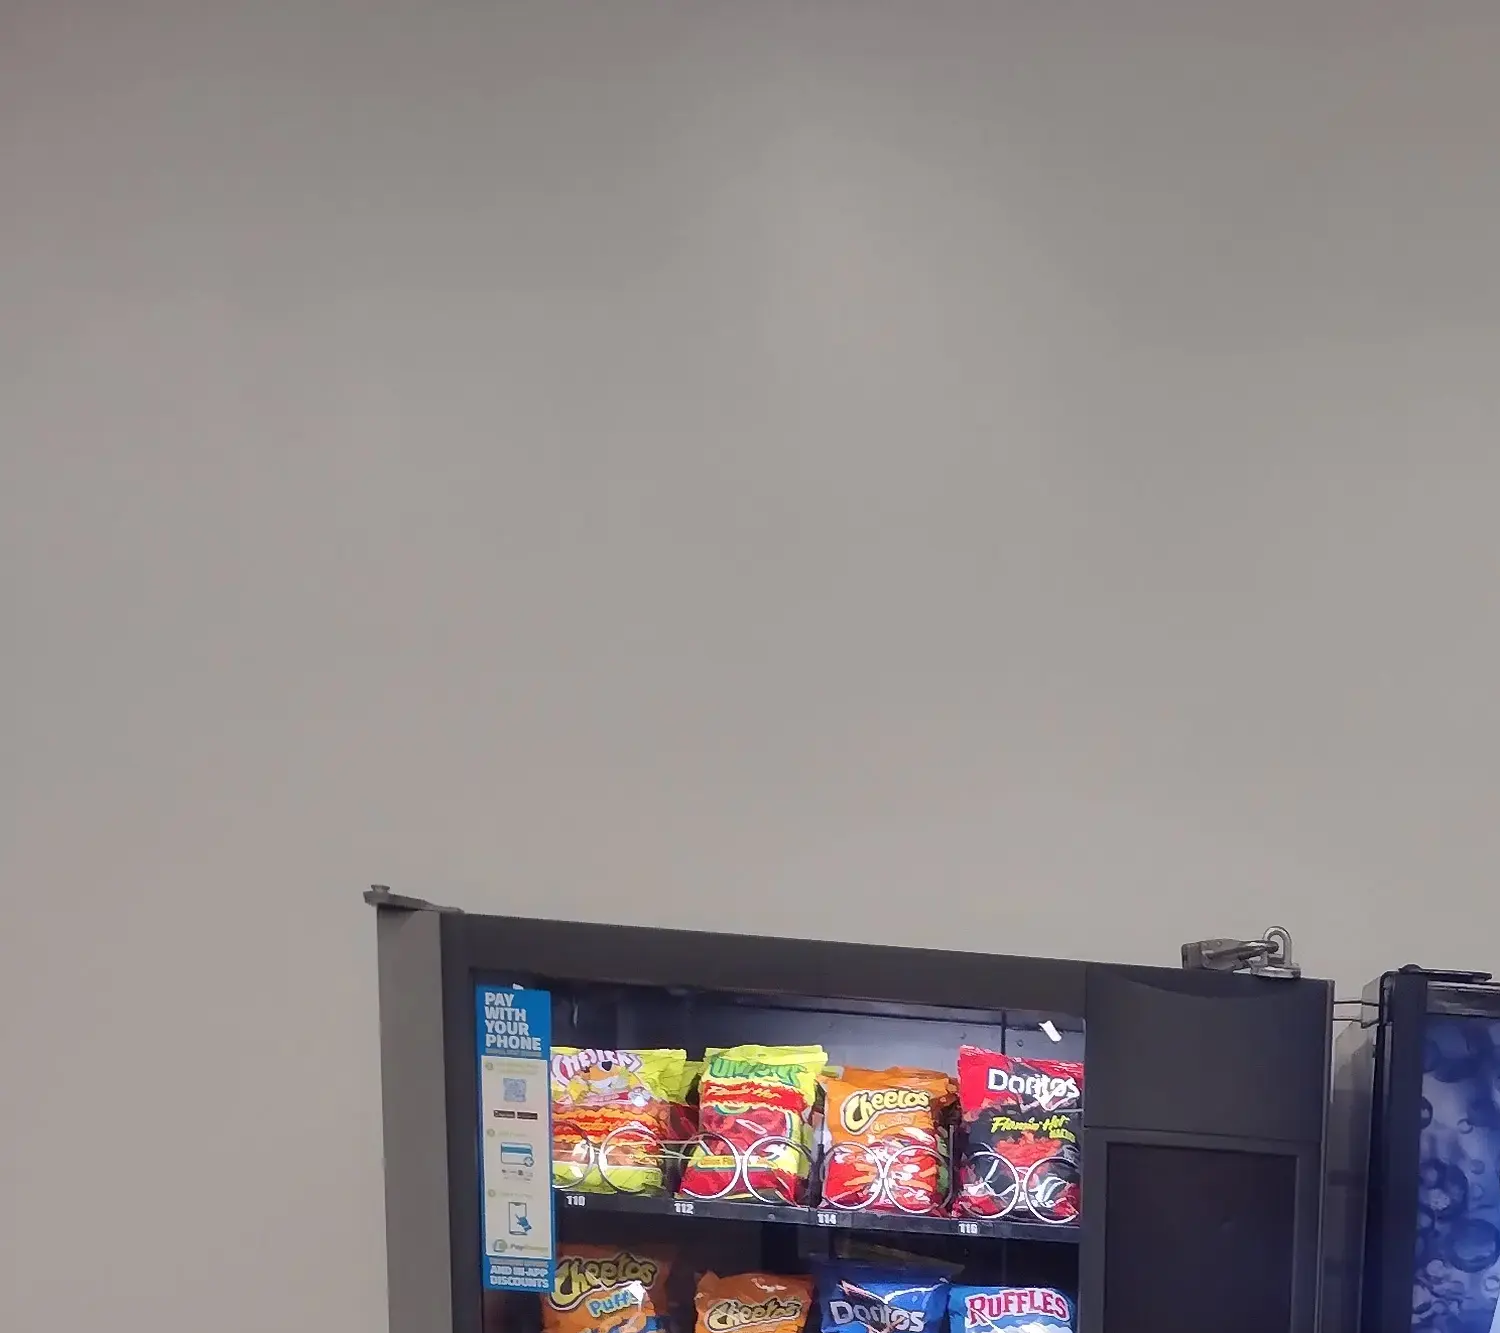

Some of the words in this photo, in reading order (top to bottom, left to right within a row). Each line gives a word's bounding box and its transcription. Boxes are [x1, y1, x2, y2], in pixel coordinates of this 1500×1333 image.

[484, 992, 514, 1006] PAY
[484, 1006, 527, 1022] WITH
[484, 1020, 529, 1036] YOUR
[485, 1034, 542, 1051] PHONE
[988, 1068, 1080, 1098] Doritos
[844, 1089, 931, 1132] Cheetos
[674, 1203, 694, 1215] 112
[817, 1213, 837, 1225] 114
[490, 1265, 512, 1275] AND
[489, 1275, 549, 1288] DISCOUNTS
[551, 1254, 658, 1308] Cheetos
[587, 1288, 636, 1317] Puff
[969, 1289, 1070, 1325] RUFFLES
[707, 1298, 802, 1332] Cheetos
[829, 1300, 925, 1332] Doritos
